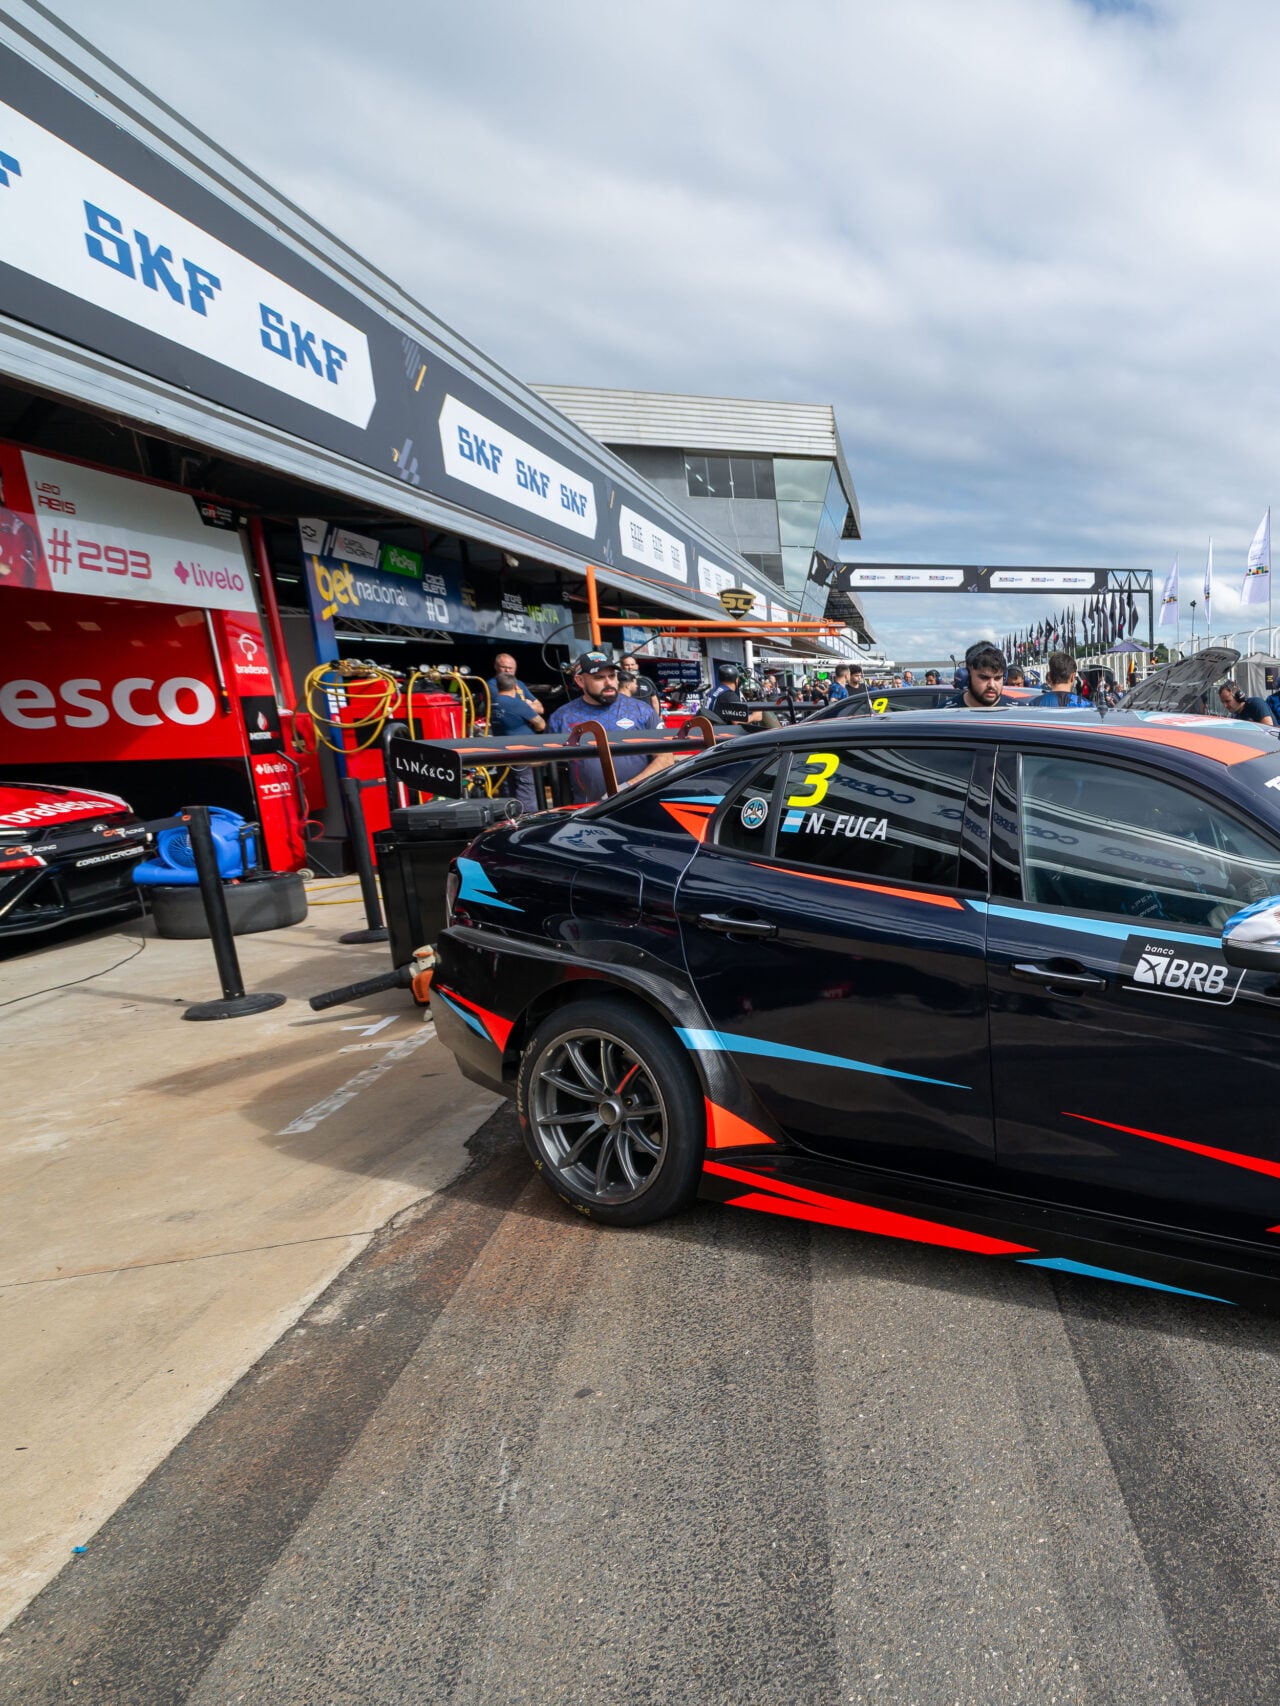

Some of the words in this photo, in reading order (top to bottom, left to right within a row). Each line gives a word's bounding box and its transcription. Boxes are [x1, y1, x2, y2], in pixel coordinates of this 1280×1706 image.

[83, 200, 221, 317] SKF
[260, 303, 347, 385] SKF
[458, 425, 503, 474] SKF
[516, 458, 550, 499] SKF
[560, 484, 588, 517] SKF
[48, 528, 152, 580] #293
[191, 562, 244, 592] livelo
[872, 697, 888, 714] 9
[787, 753, 840, 807] 3
[806, 813, 826, 835] N.
[832, 815, 888, 841] FUCA
[1145, 943, 1175, 955] banco
[1164, 959, 1229, 994] BRB
